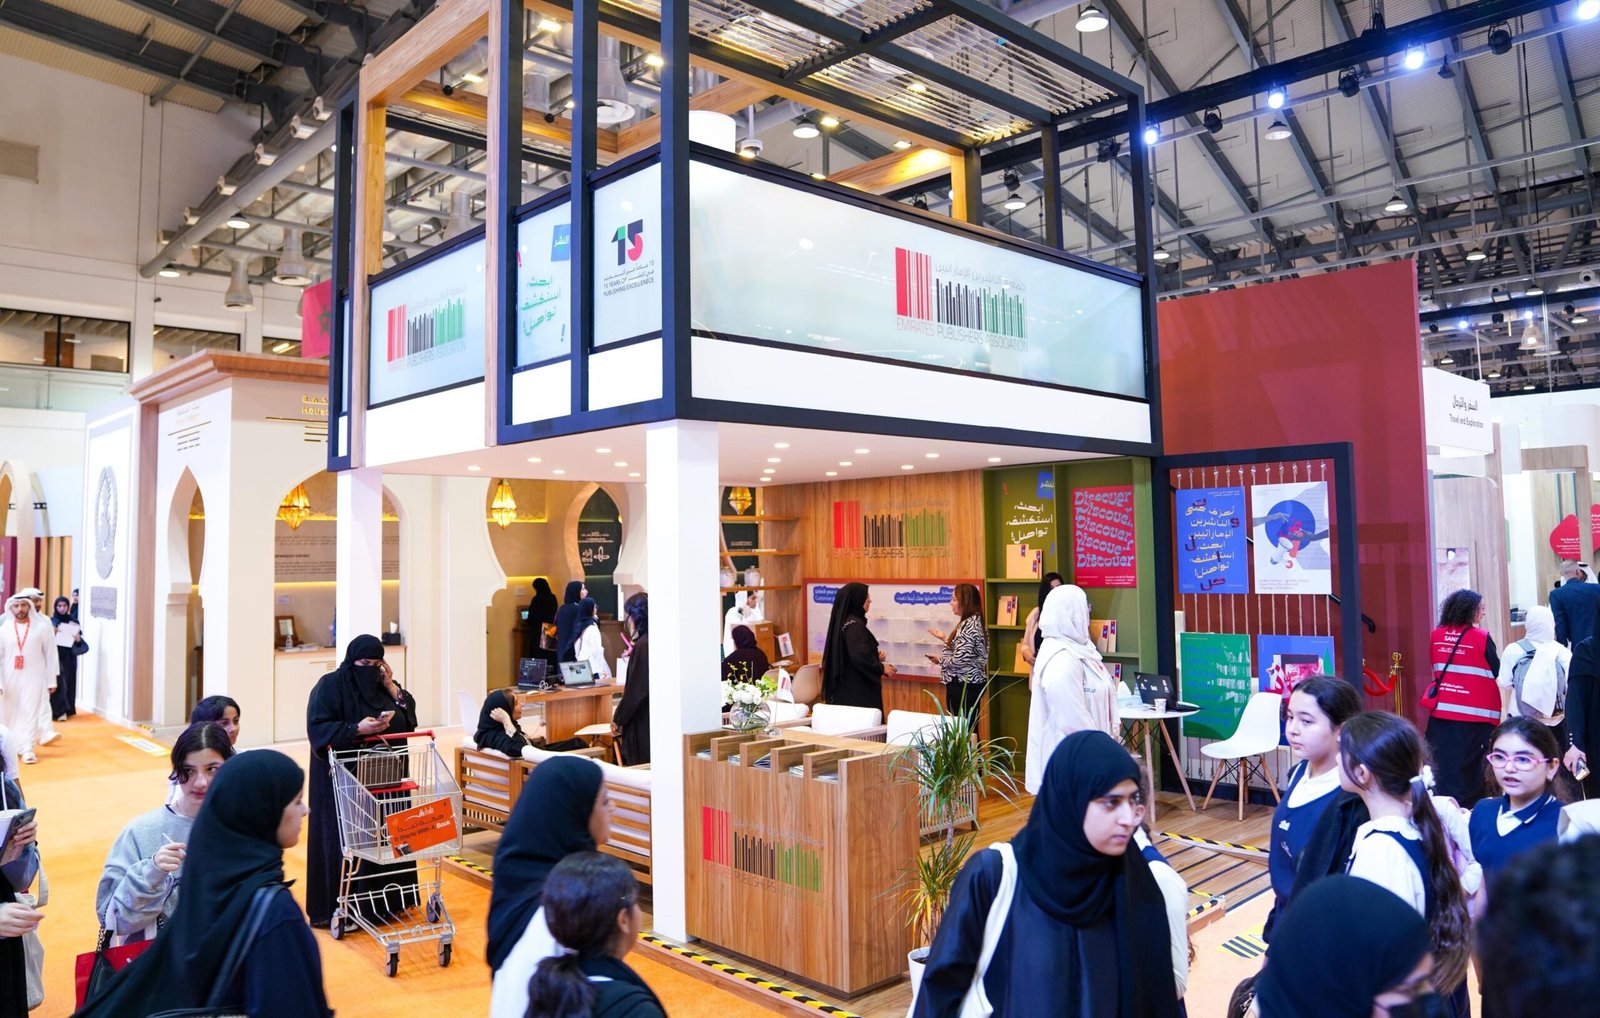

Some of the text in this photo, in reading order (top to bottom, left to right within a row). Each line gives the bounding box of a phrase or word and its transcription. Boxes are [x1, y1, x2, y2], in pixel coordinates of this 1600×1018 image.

[611, 219, 643, 266] 15
[603, 285, 626, 297] PUBLISHING
[609, 279, 620, 288] YEARS
[896, 317, 1029, 352] EMIRATES PUBLISHERS ASSOCIATION
[1449, 413, 1459, 424] Travel
[1466, 417, 1484, 429] Exploration
[1075, 490, 1132, 507] Discover
[1190, 517, 1230, 528] الناشرين
[863, 547, 904, 558] PUBLISHERS
[1077, 553, 1134, 568] Discover
[400, 831, 416, 841] Starts
[417, 827, 430, 835] With
[436, 820, 451, 829] Book
[734, 870, 777, 894] PUBLISHERS
